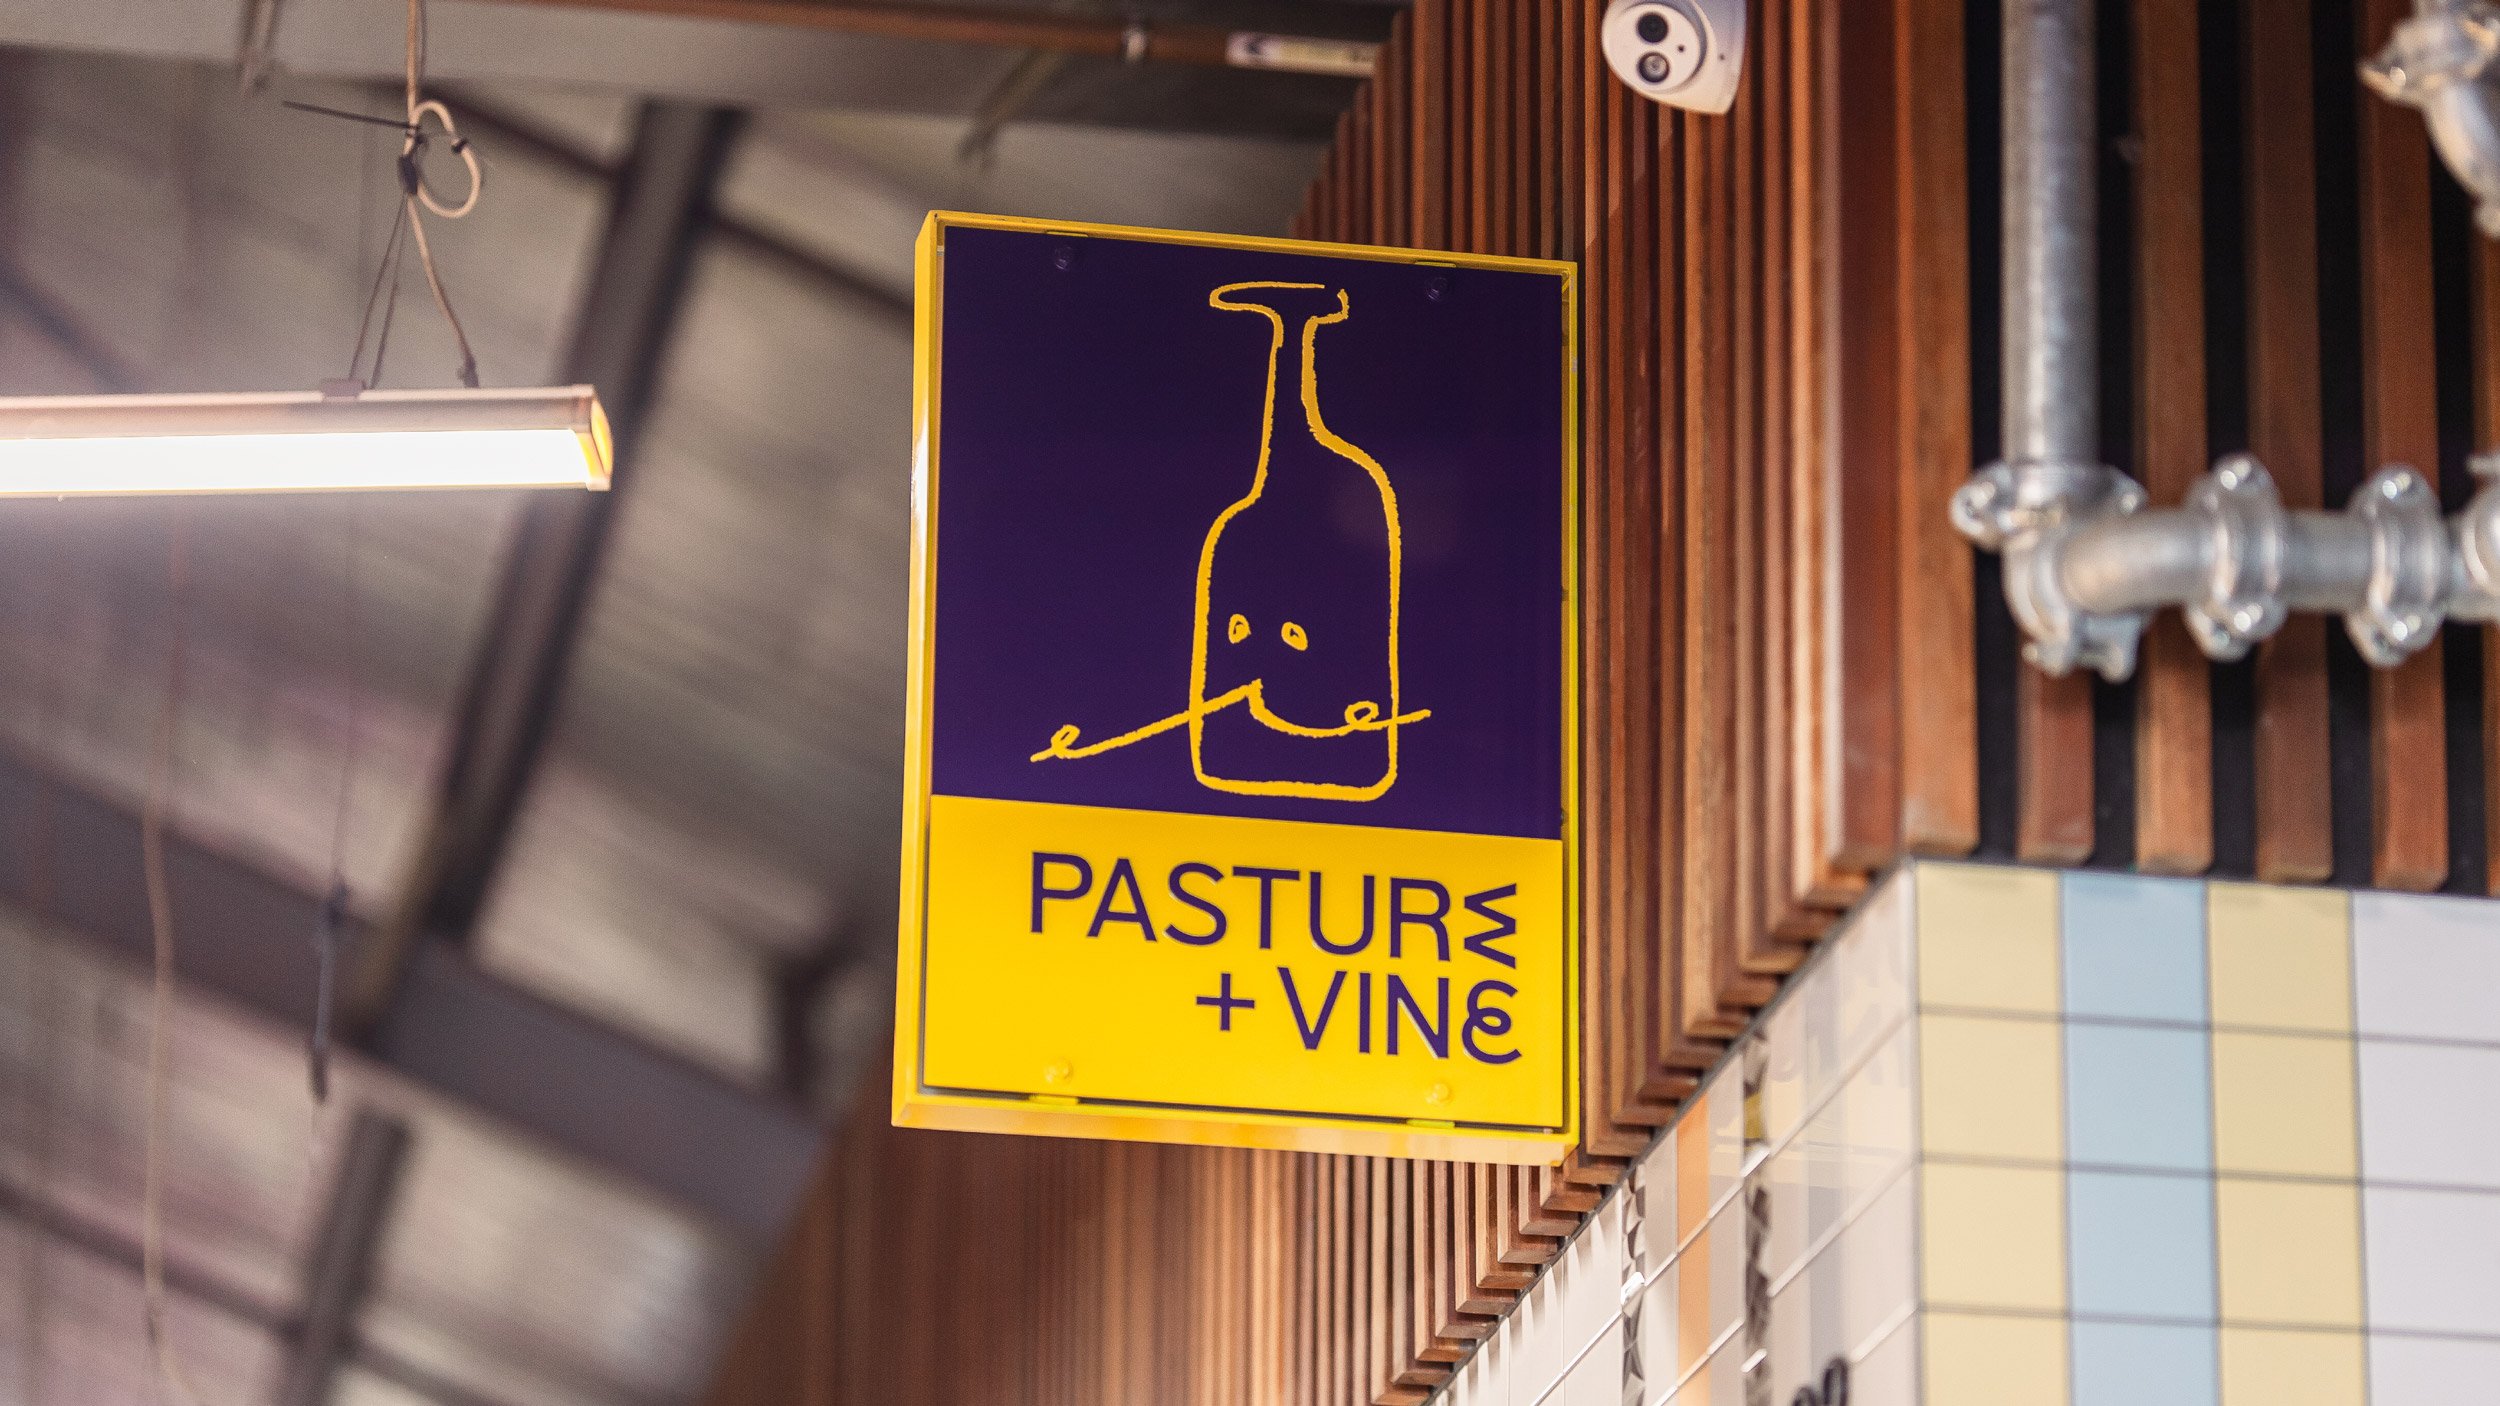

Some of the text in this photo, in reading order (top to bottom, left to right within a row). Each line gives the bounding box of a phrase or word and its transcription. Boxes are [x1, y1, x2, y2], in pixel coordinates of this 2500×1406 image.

[1030, 850, 1518, 970] PASTURE
[1195, 965, 1523, 1065] + VINE
